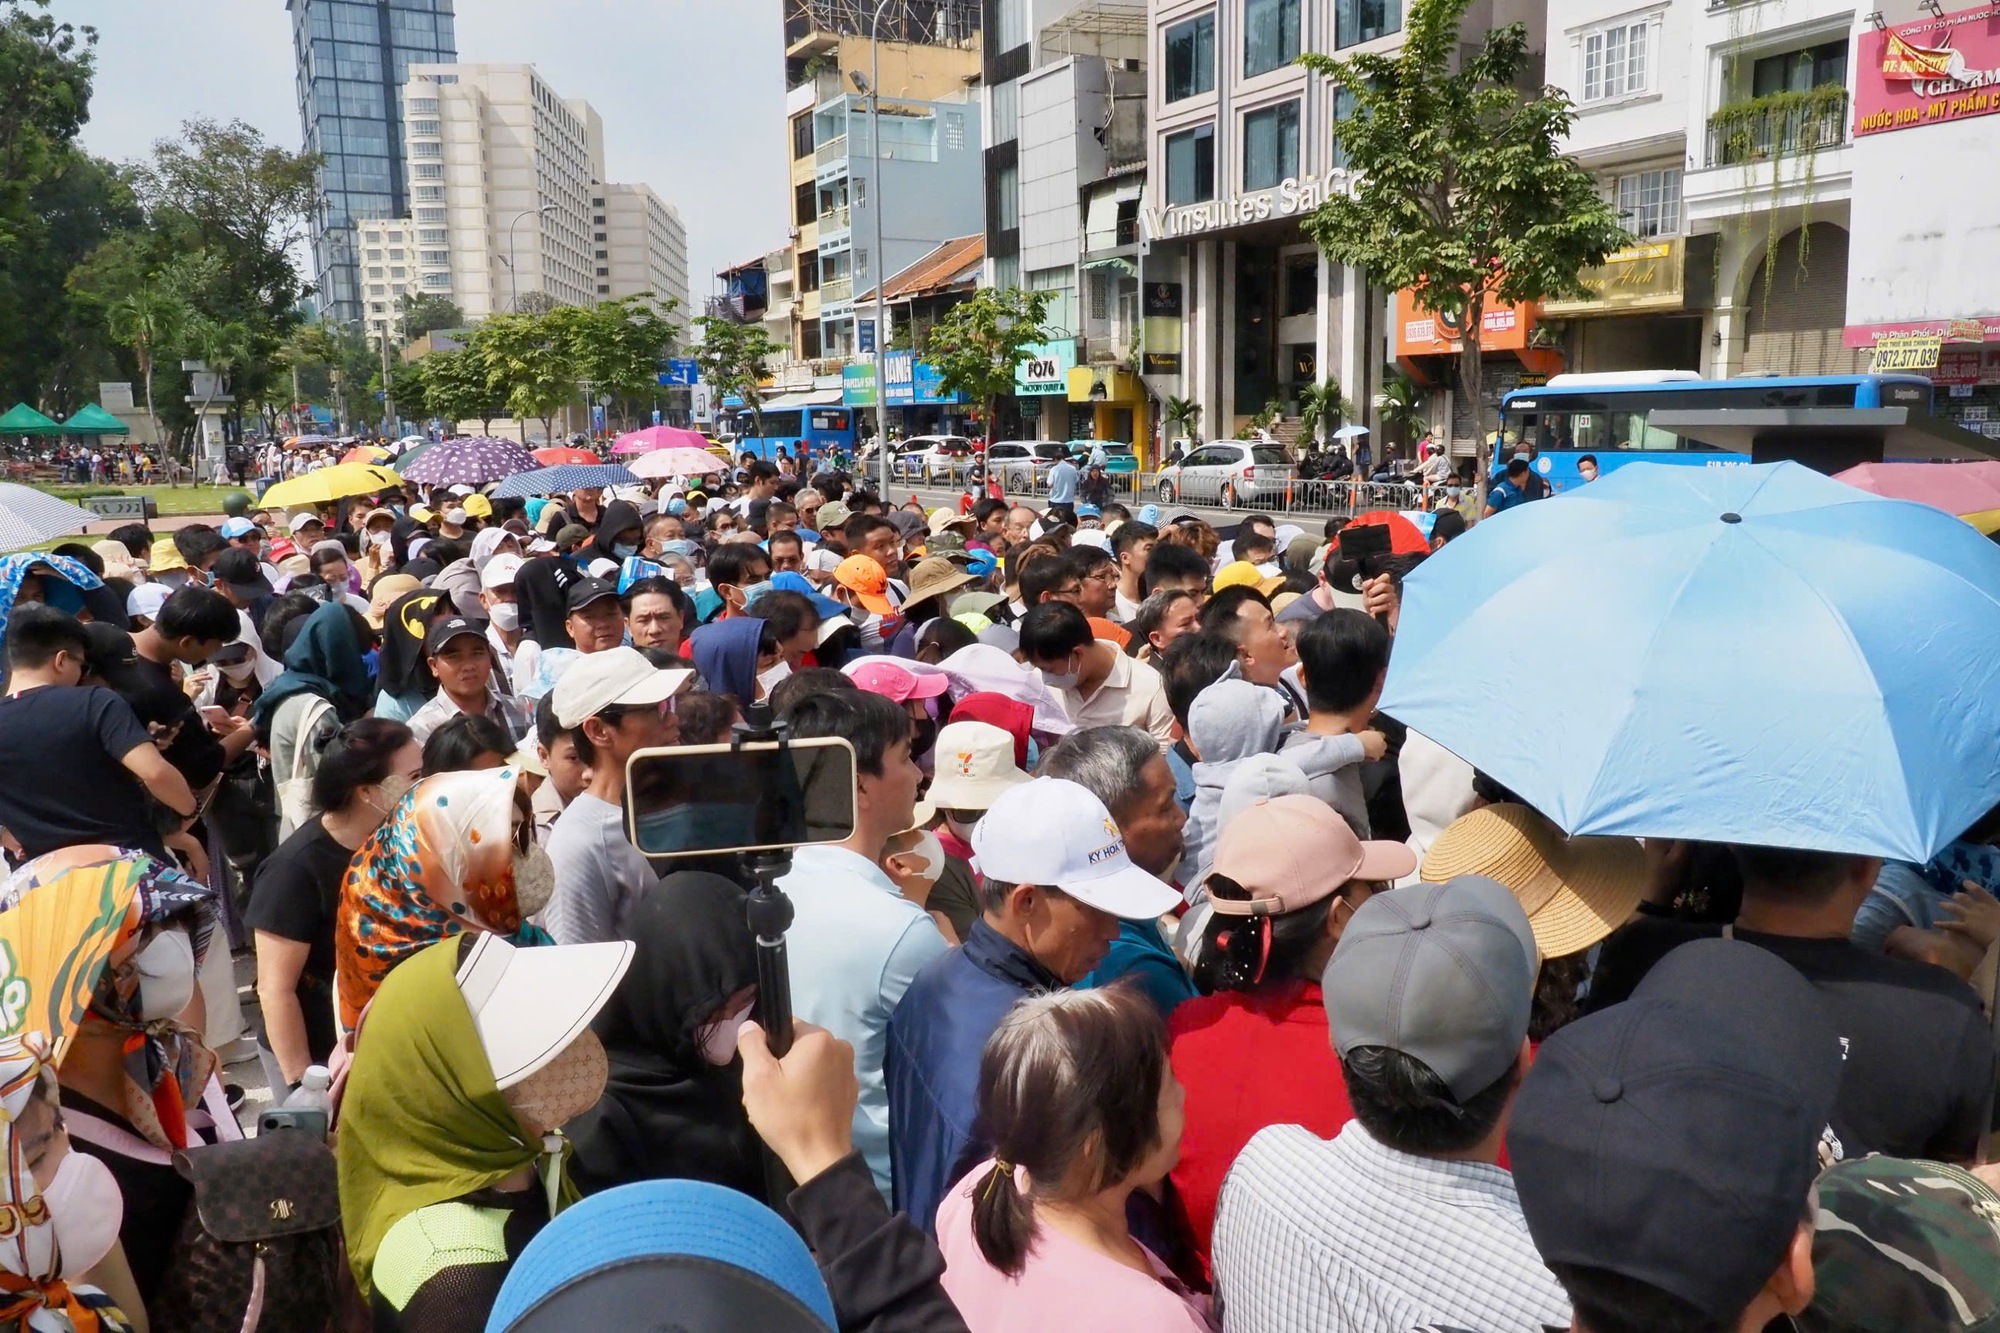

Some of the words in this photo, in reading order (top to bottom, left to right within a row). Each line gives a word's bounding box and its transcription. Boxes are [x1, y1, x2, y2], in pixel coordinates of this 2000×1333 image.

[1923, 23, 1933, 32] TY
[1861, 109, 1893, 131] NƯỚC
[1896, 107, 1919, 123] HOA
[1928, 99, 1947, 118] MỸ
[1951, 90, 1988, 114] PHẨM
[1137, 194, 1271, 239] Winsuites
[1876, 347, 1939, 368] 0972.377.039
[1028, 360, 1055, 377] FO76
[844, 378, 864, 389] FAMILY
[865, 376, 876, 388] SPA
[1581, 417, 1590, 426] 31
